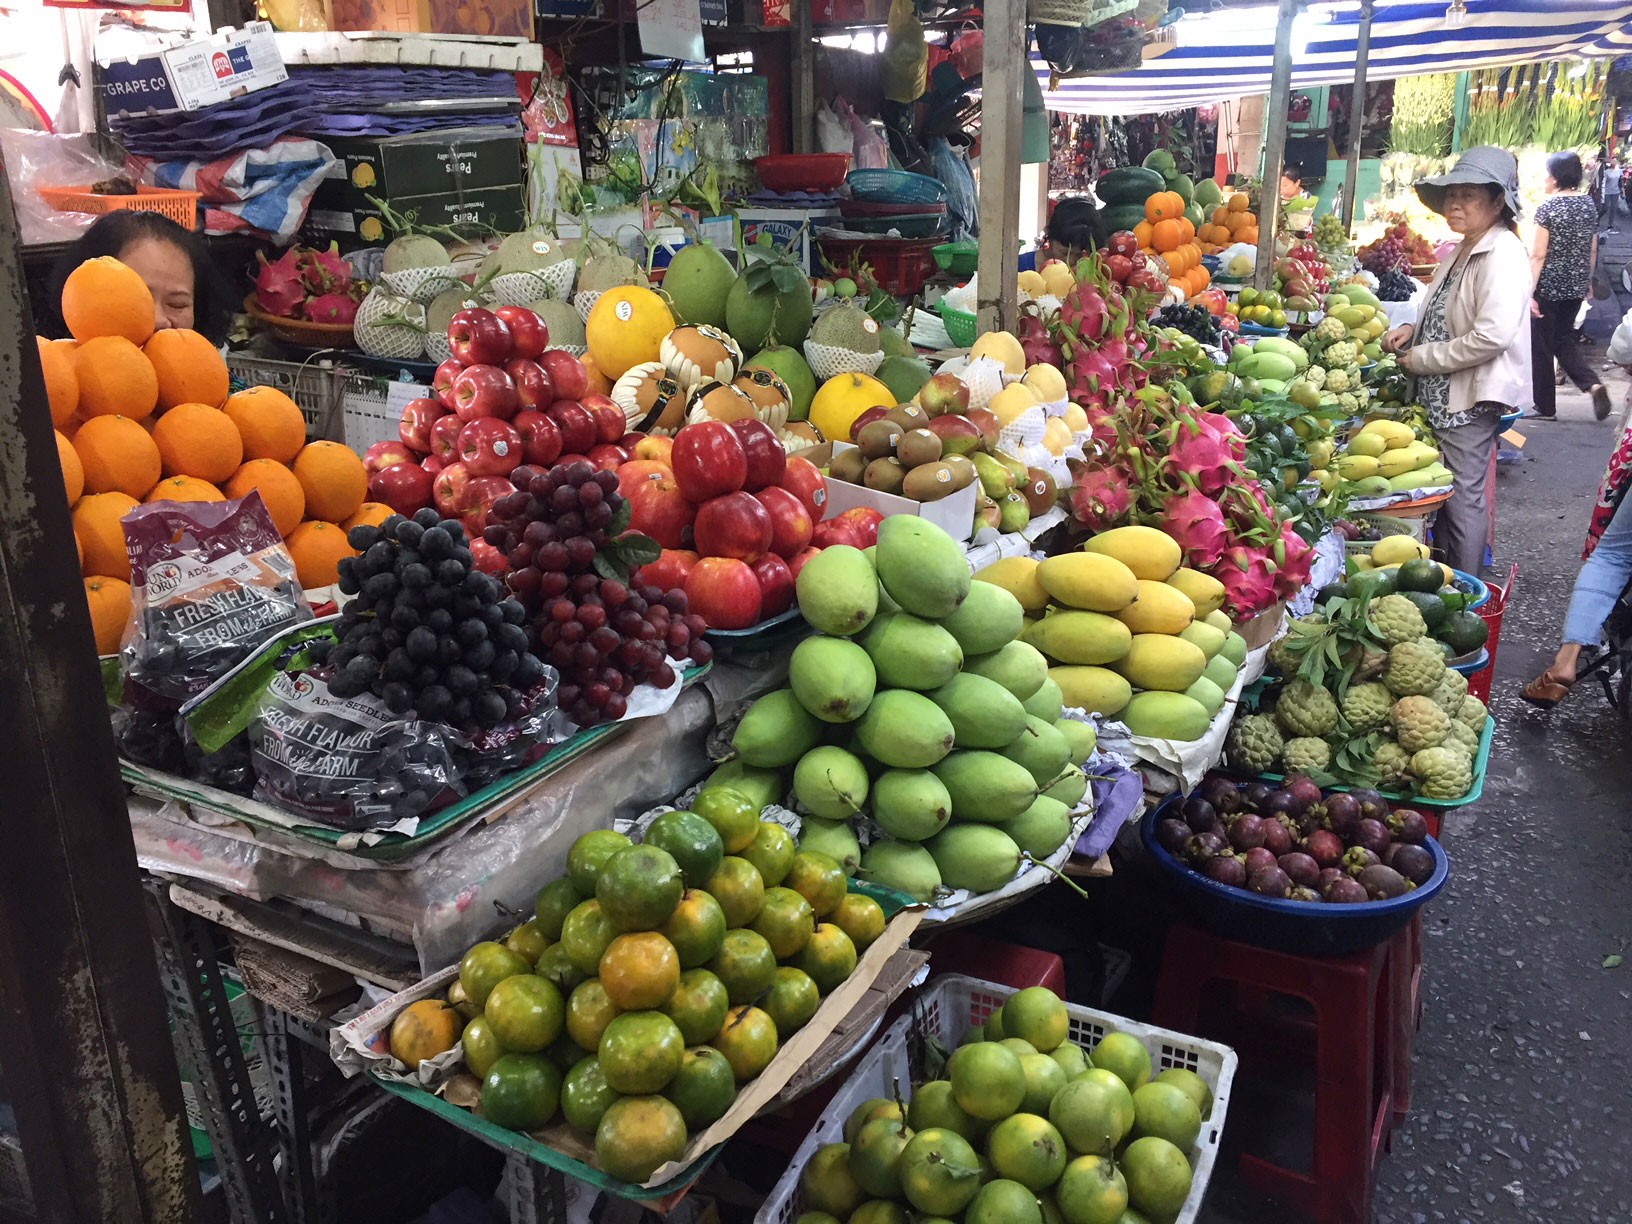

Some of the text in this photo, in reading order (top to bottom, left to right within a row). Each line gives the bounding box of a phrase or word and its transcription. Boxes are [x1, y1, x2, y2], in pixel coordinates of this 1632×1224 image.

[232, 55, 245, 65] THE
[106, 79, 150, 96] GRAPE
[445, 161, 472, 174] Pears
[453, 212, 478, 224] Pears
[762, 223, 792, 238] GALAXY
[535, 244, 549, 252] WIN
[173, 592, 228, 628] FRESH
[193, 616, 245, 649] FROM
[262, 705, 308, 736] FRESH
[263, 734, 294, 764] FROM
